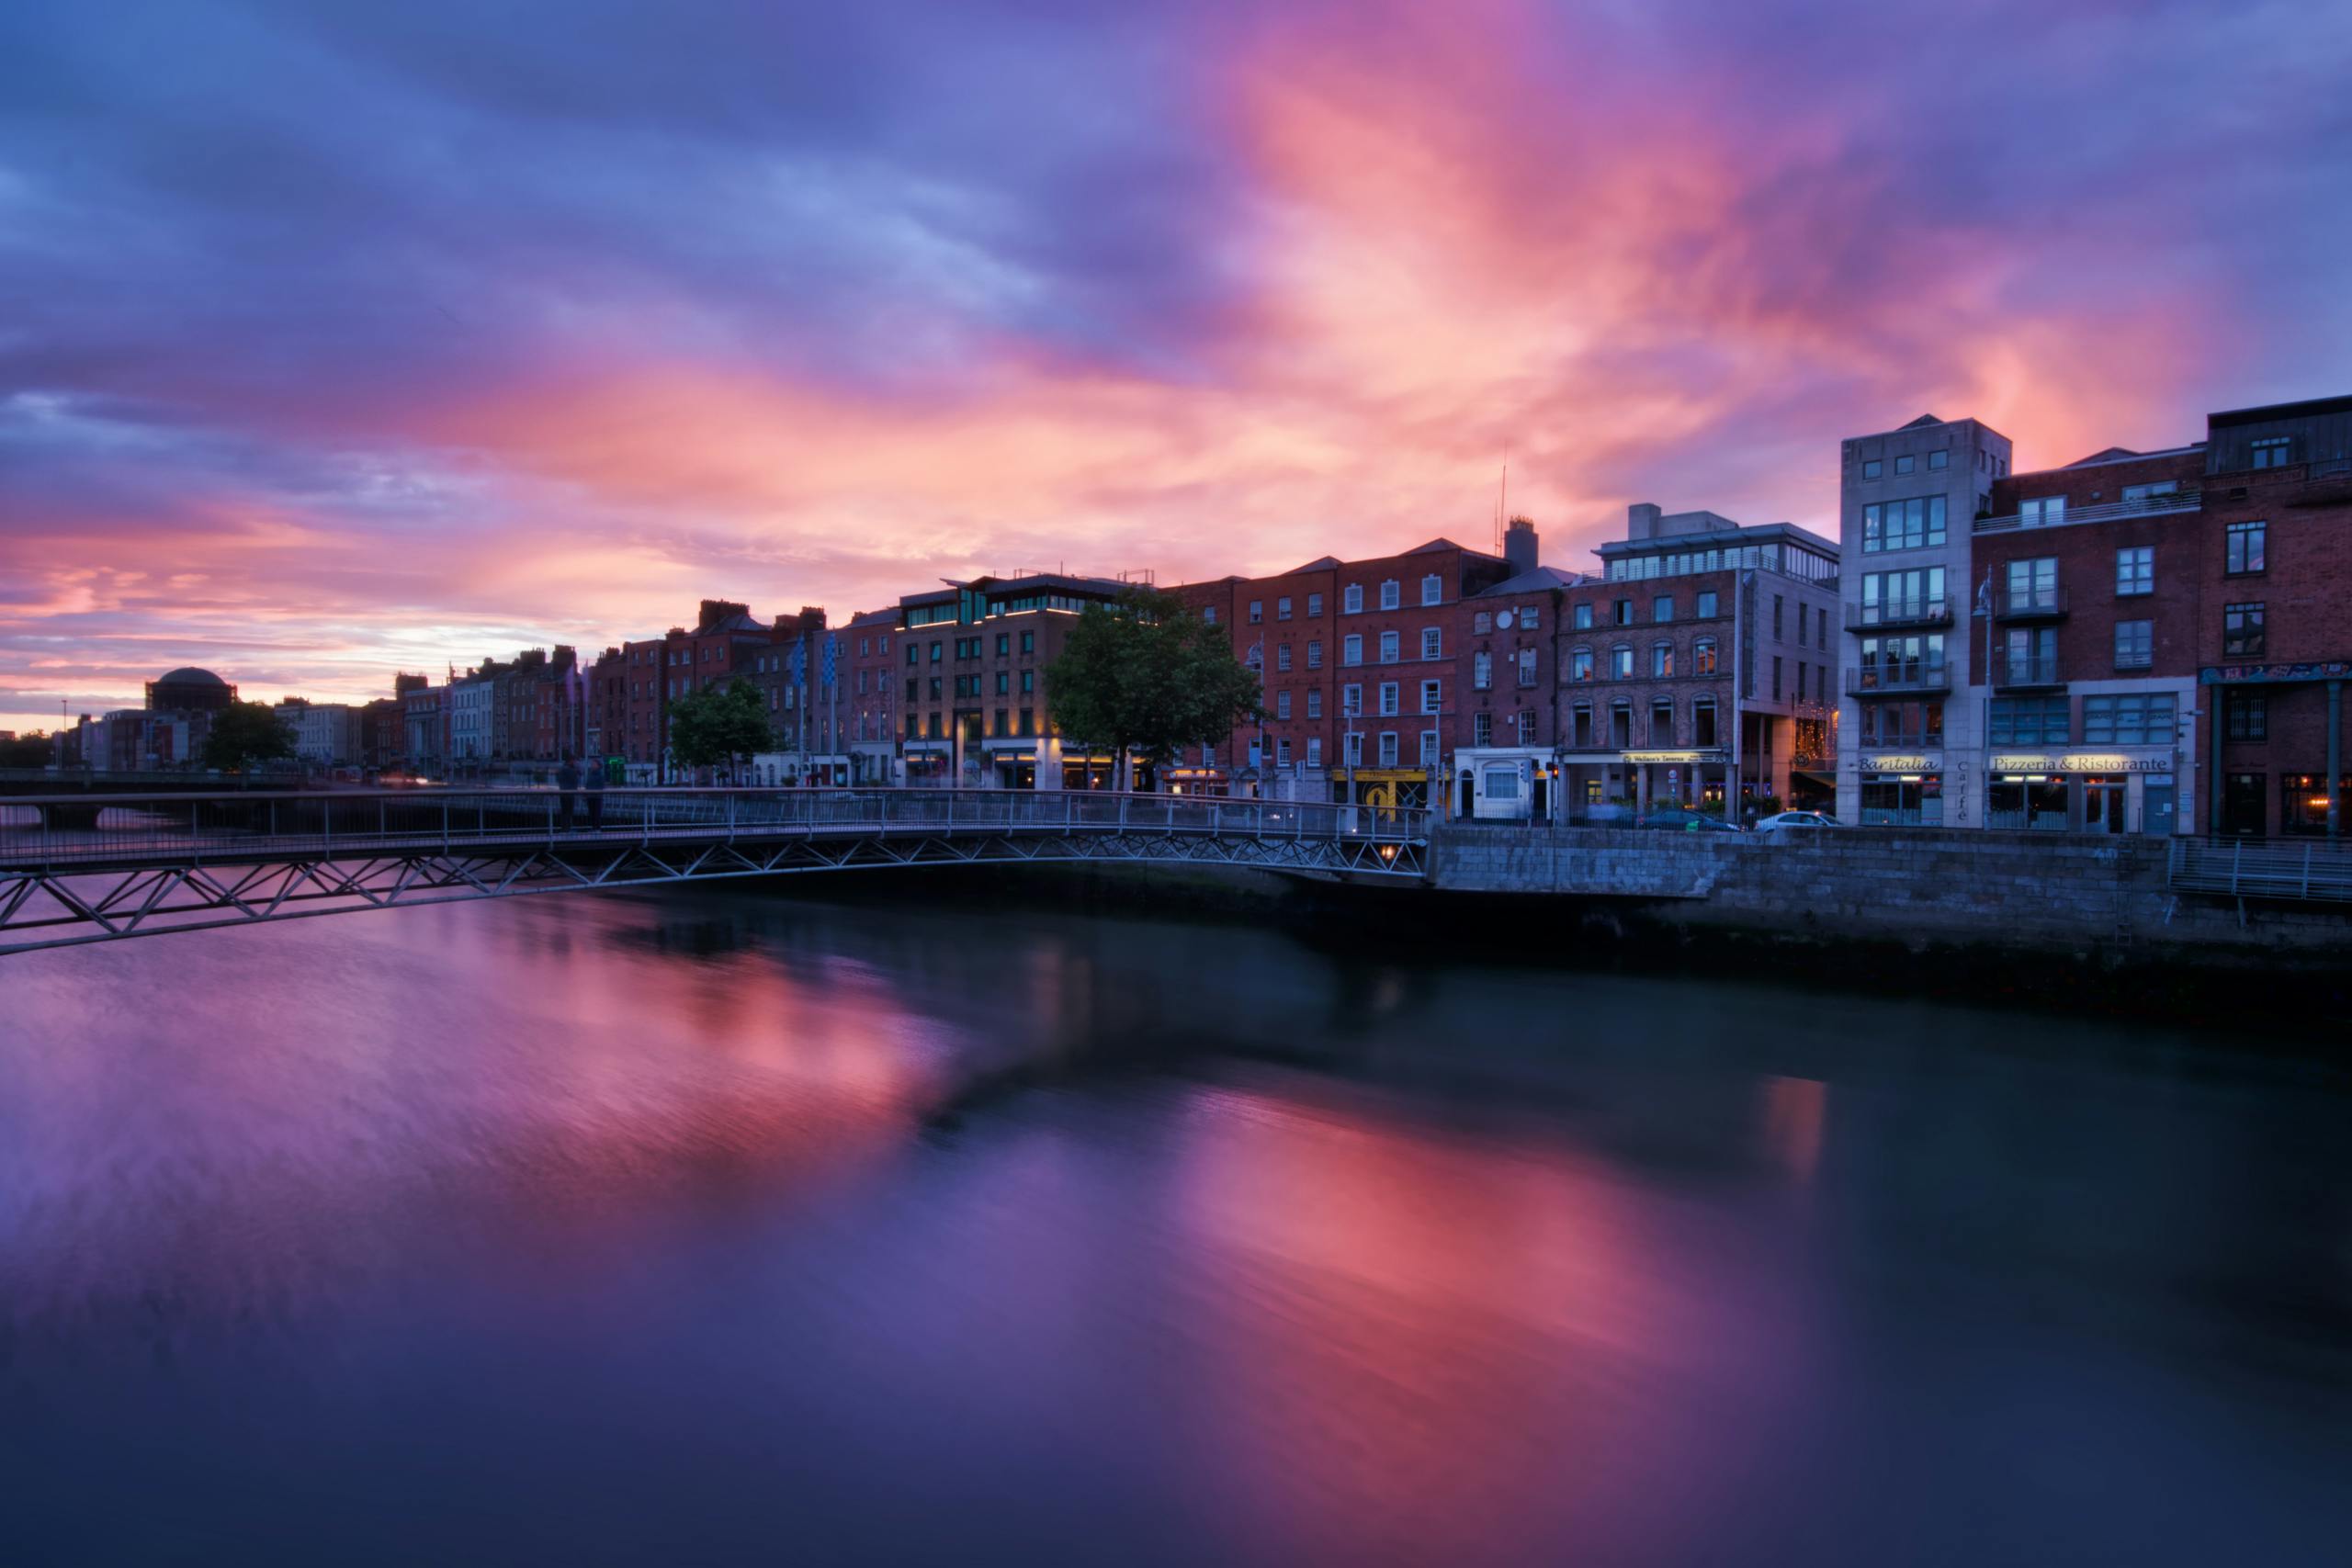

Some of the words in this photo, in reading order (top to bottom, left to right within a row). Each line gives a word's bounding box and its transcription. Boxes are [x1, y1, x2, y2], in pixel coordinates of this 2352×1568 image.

[1860, 758, 1938, 771] Baritalia
[1994, 757, 2056, 770] Pizzeria
[2060, 758, 2073, 770] &
[2077, 757, 2166, 770] Ristorante
